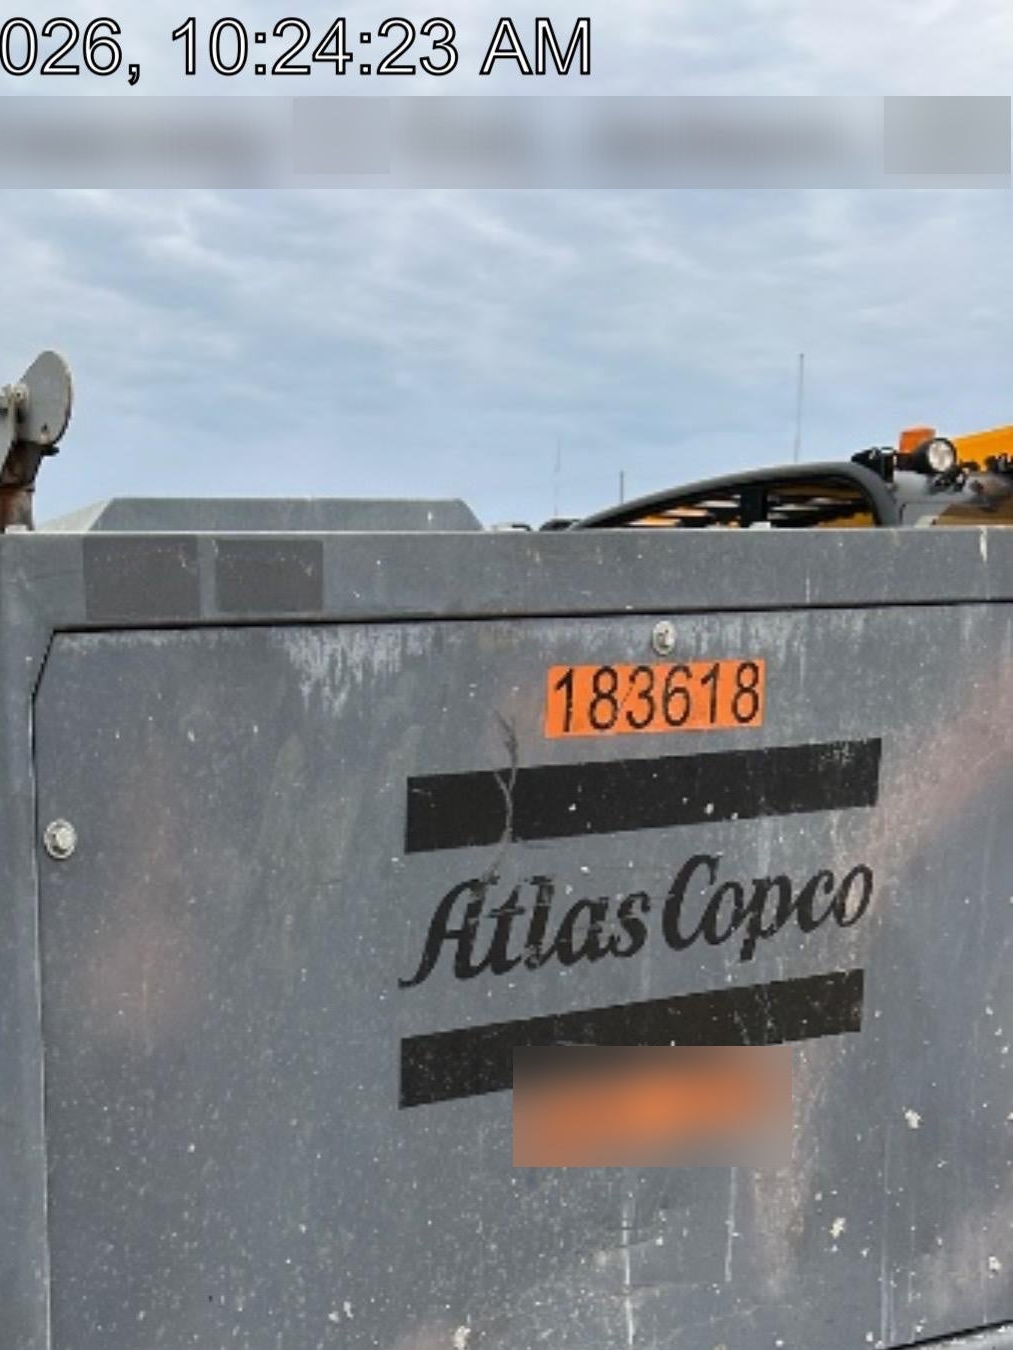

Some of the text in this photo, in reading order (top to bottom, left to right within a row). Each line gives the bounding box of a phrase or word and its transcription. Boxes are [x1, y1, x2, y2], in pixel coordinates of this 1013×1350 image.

[554, 661, 760, 732] 183618
[397, 853, 874, 988] Atlas Copco
